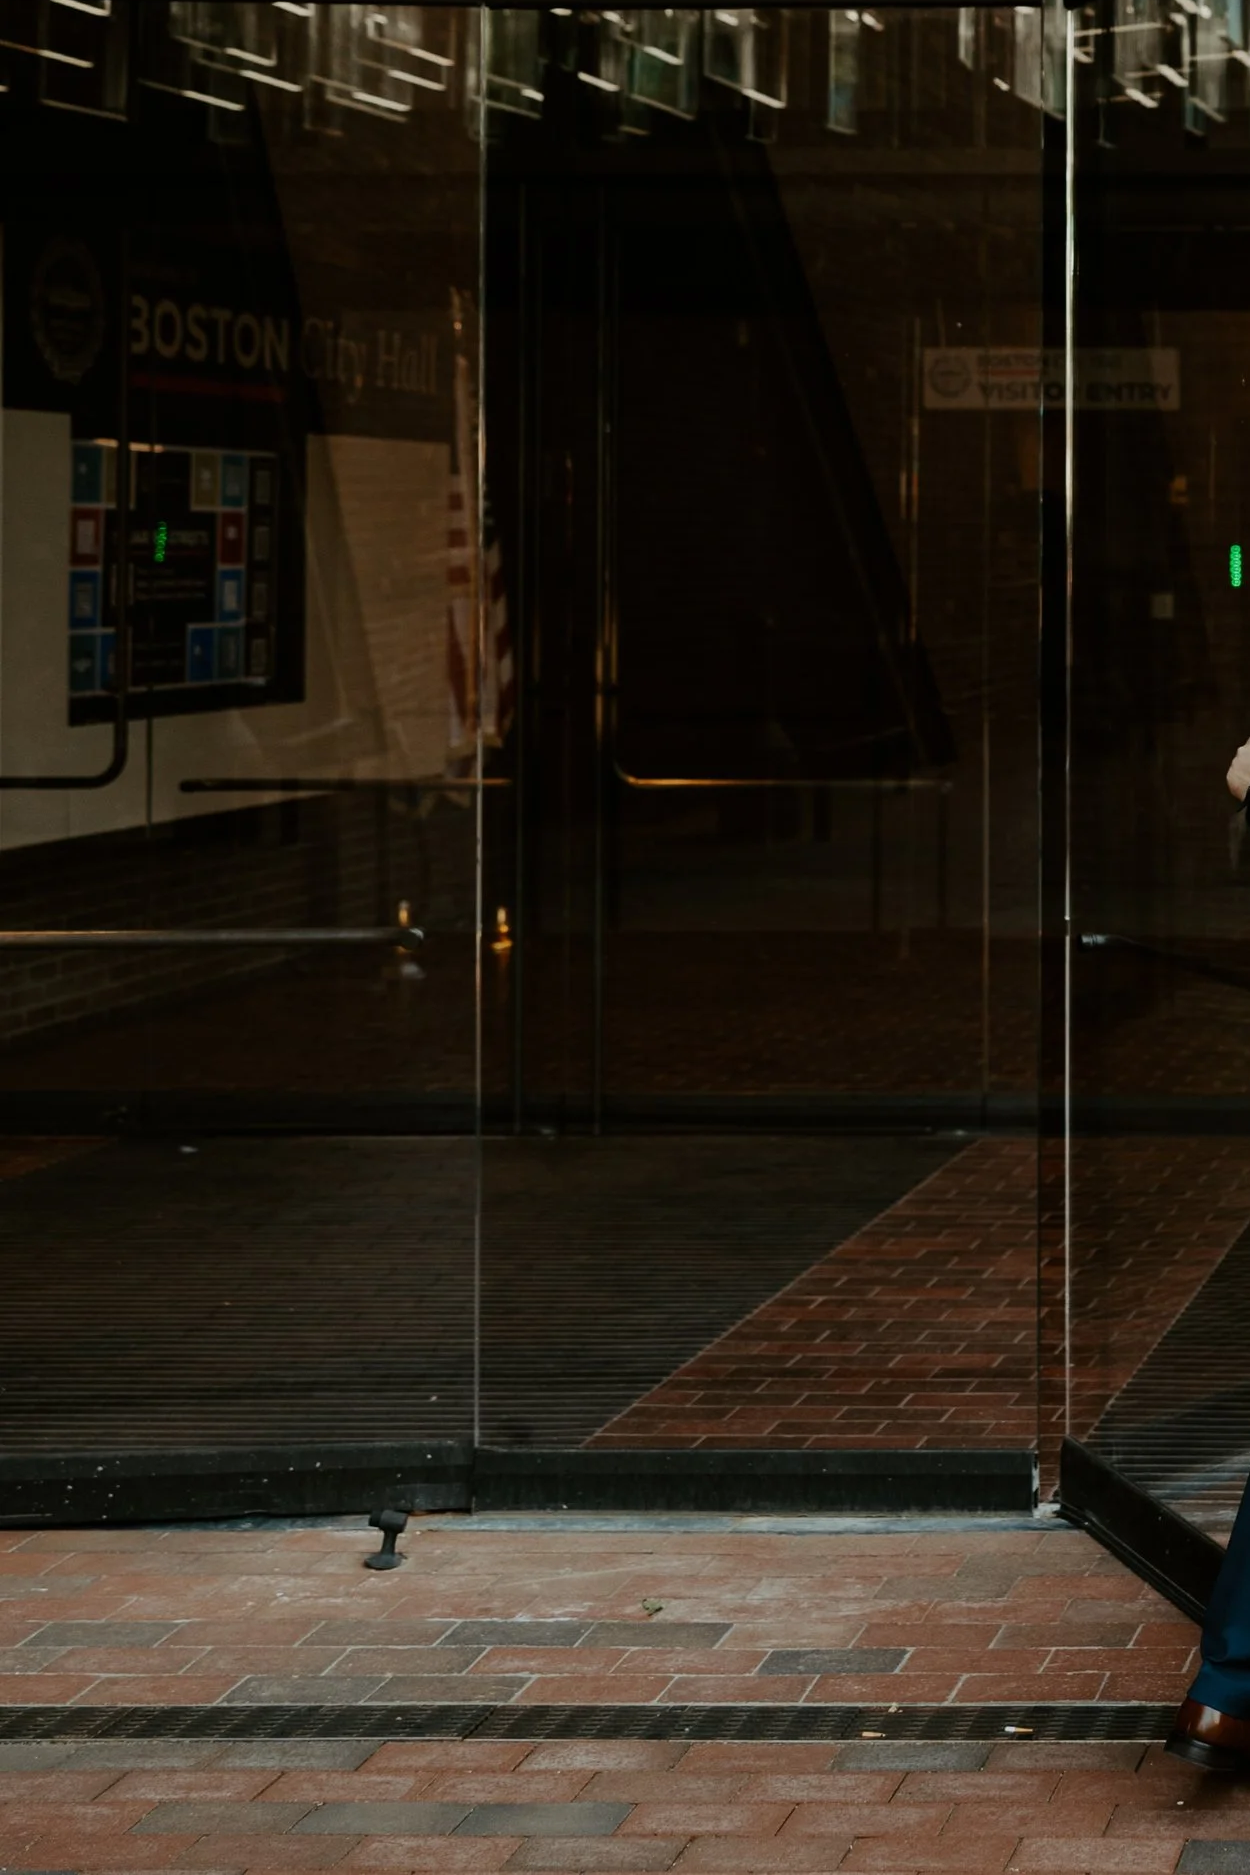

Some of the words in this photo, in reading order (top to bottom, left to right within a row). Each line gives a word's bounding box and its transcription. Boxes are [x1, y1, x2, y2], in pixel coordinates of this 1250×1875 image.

[129, 293, 292, 373] BOSTON
[374, 327, 439, 396] Hall
[977, 380, 1079, 403] VISITO
